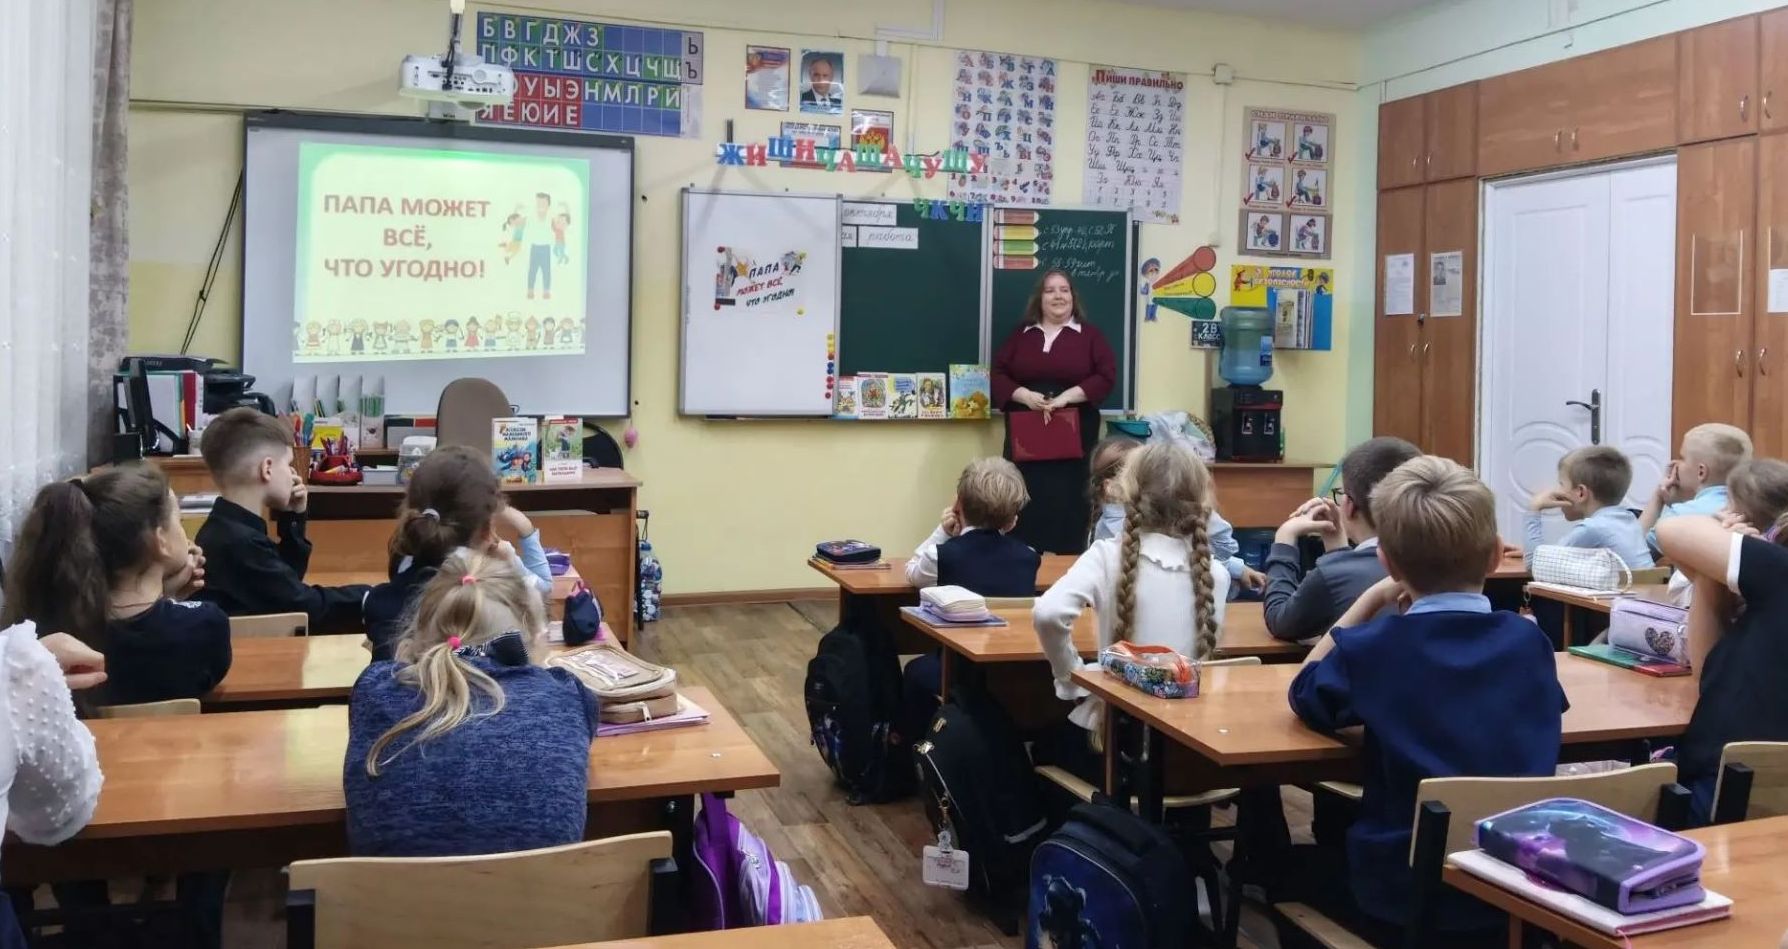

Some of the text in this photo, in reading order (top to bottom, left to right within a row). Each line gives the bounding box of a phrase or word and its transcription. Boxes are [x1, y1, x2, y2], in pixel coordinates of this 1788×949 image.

[483, 18, 599, 47] Б В Г Д Ж З
[688, 36, 699, 55] Ь
[482, 44, 681, 80] П Ф К Т Ш С Х Ц Ч Щ
[685, 60, 698, 79] Ъ
[524, 77, 539, 97] У
[544, 78, 561, 98] Ы
[565, 79, 580, 100] Э
[584, 81, 599, 102] Н
[603, 83, 622, 103] М
[624, 85, 639, 105] Л
[647, 86, 659, 106] Р
[521, 101, 540, 122] Ю
[544, 103, 559, 124] И
[565, 105, 578, 125] Е
[323, 194, 491, 218] ПАПА МОЖЕТ
[383, 224, 433, 251] ВСЁ,
[323, 258, 485, 283] ЧТО УГОДНО!
[748, 262, 779, 279] ПАПА
